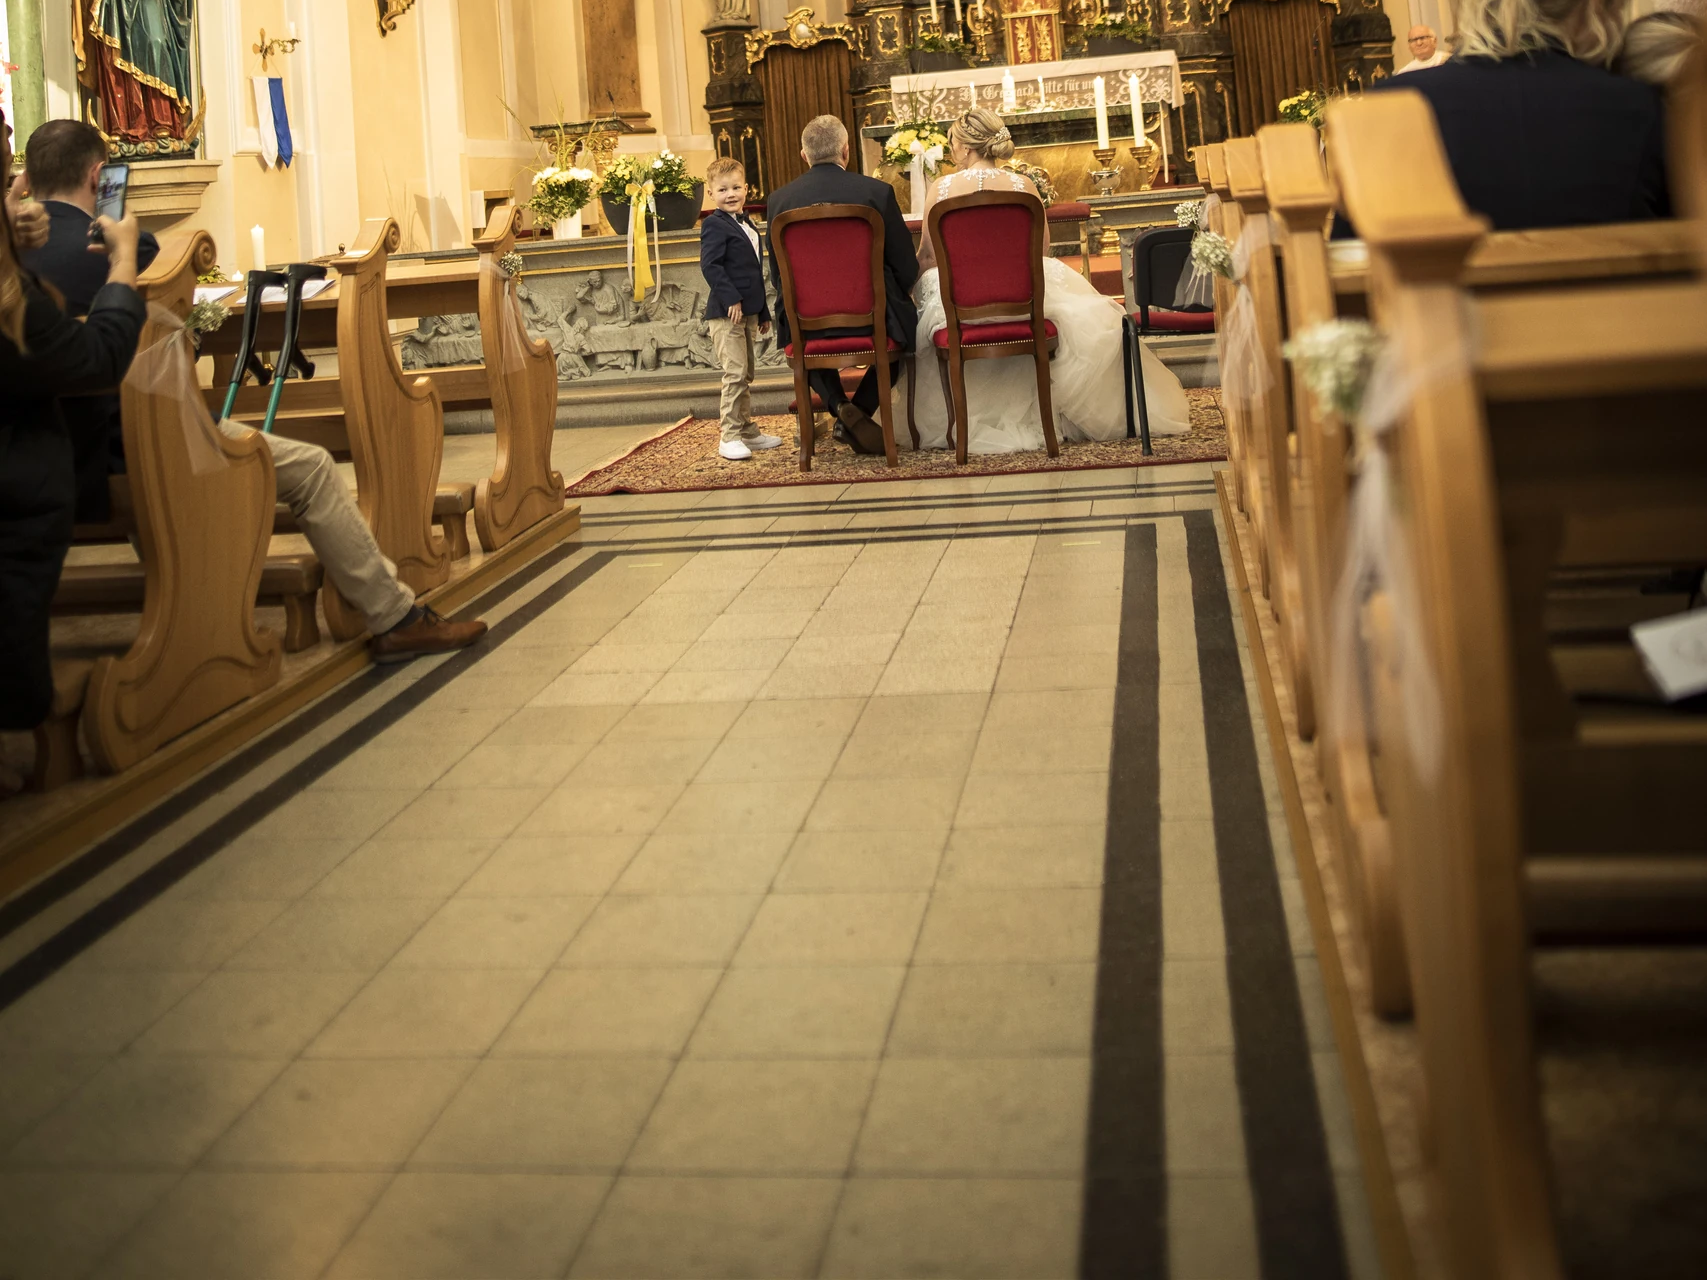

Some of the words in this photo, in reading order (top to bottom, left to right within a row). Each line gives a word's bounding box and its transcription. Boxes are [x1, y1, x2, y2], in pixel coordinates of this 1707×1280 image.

[1041, 80, 1063, 94] itte
[1064, 78, 1080, 94] für
[1081, 78, 1096, 91] un
